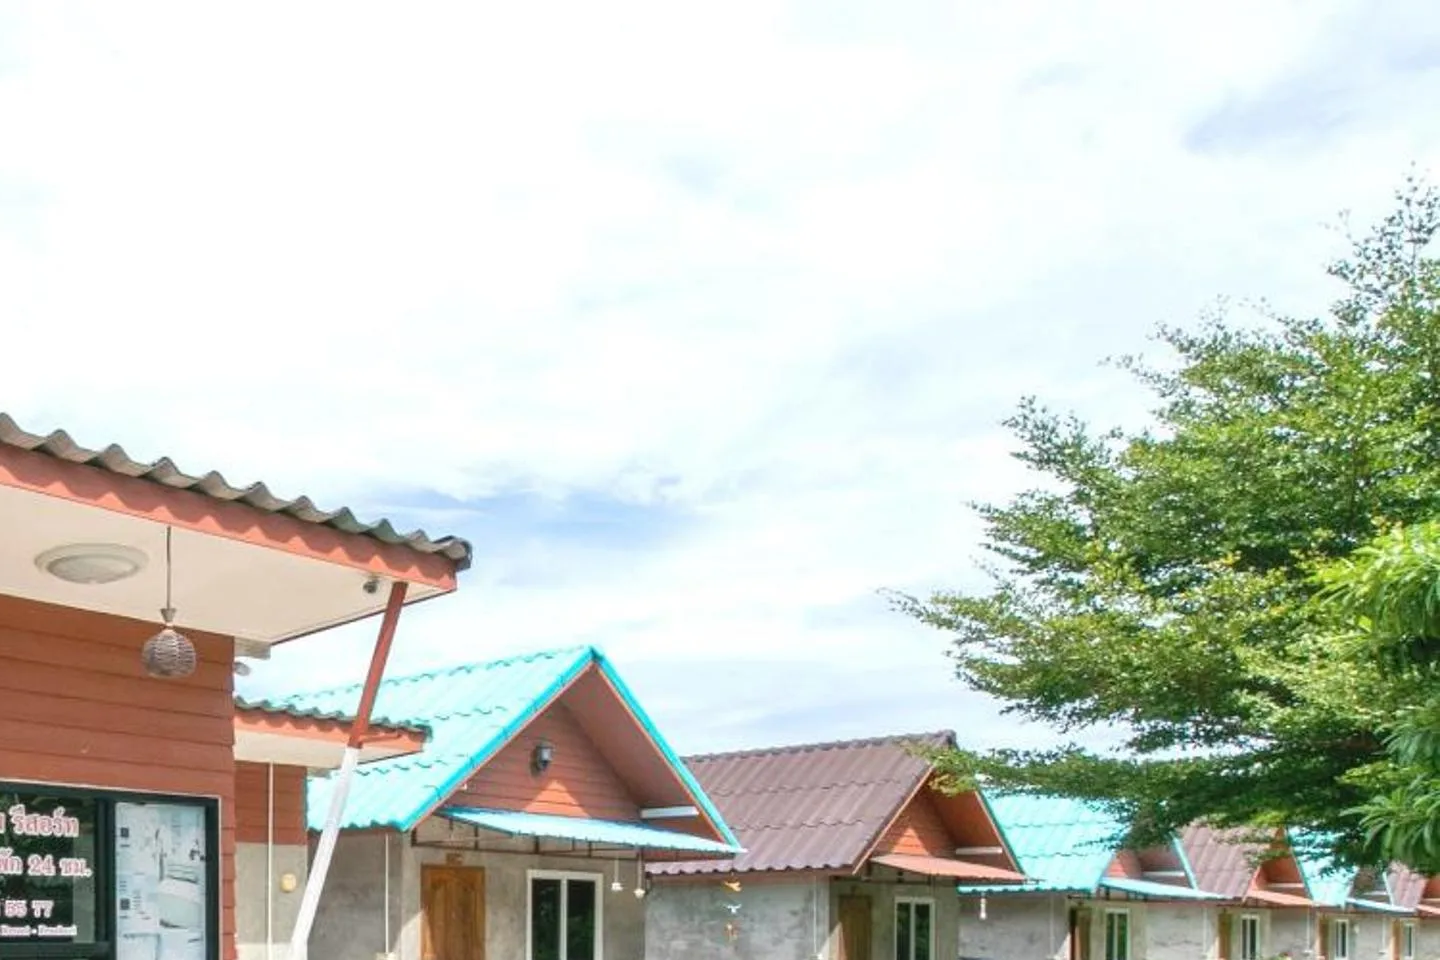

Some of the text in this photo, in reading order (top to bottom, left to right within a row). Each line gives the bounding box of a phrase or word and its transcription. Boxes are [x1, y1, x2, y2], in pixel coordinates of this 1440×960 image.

[8, 804, 79, 838] รีสอร์ท
[27, 854, 56, 877] 24
[5, 899, 28, 918] 55
[31, 899, 54, 918] 77
